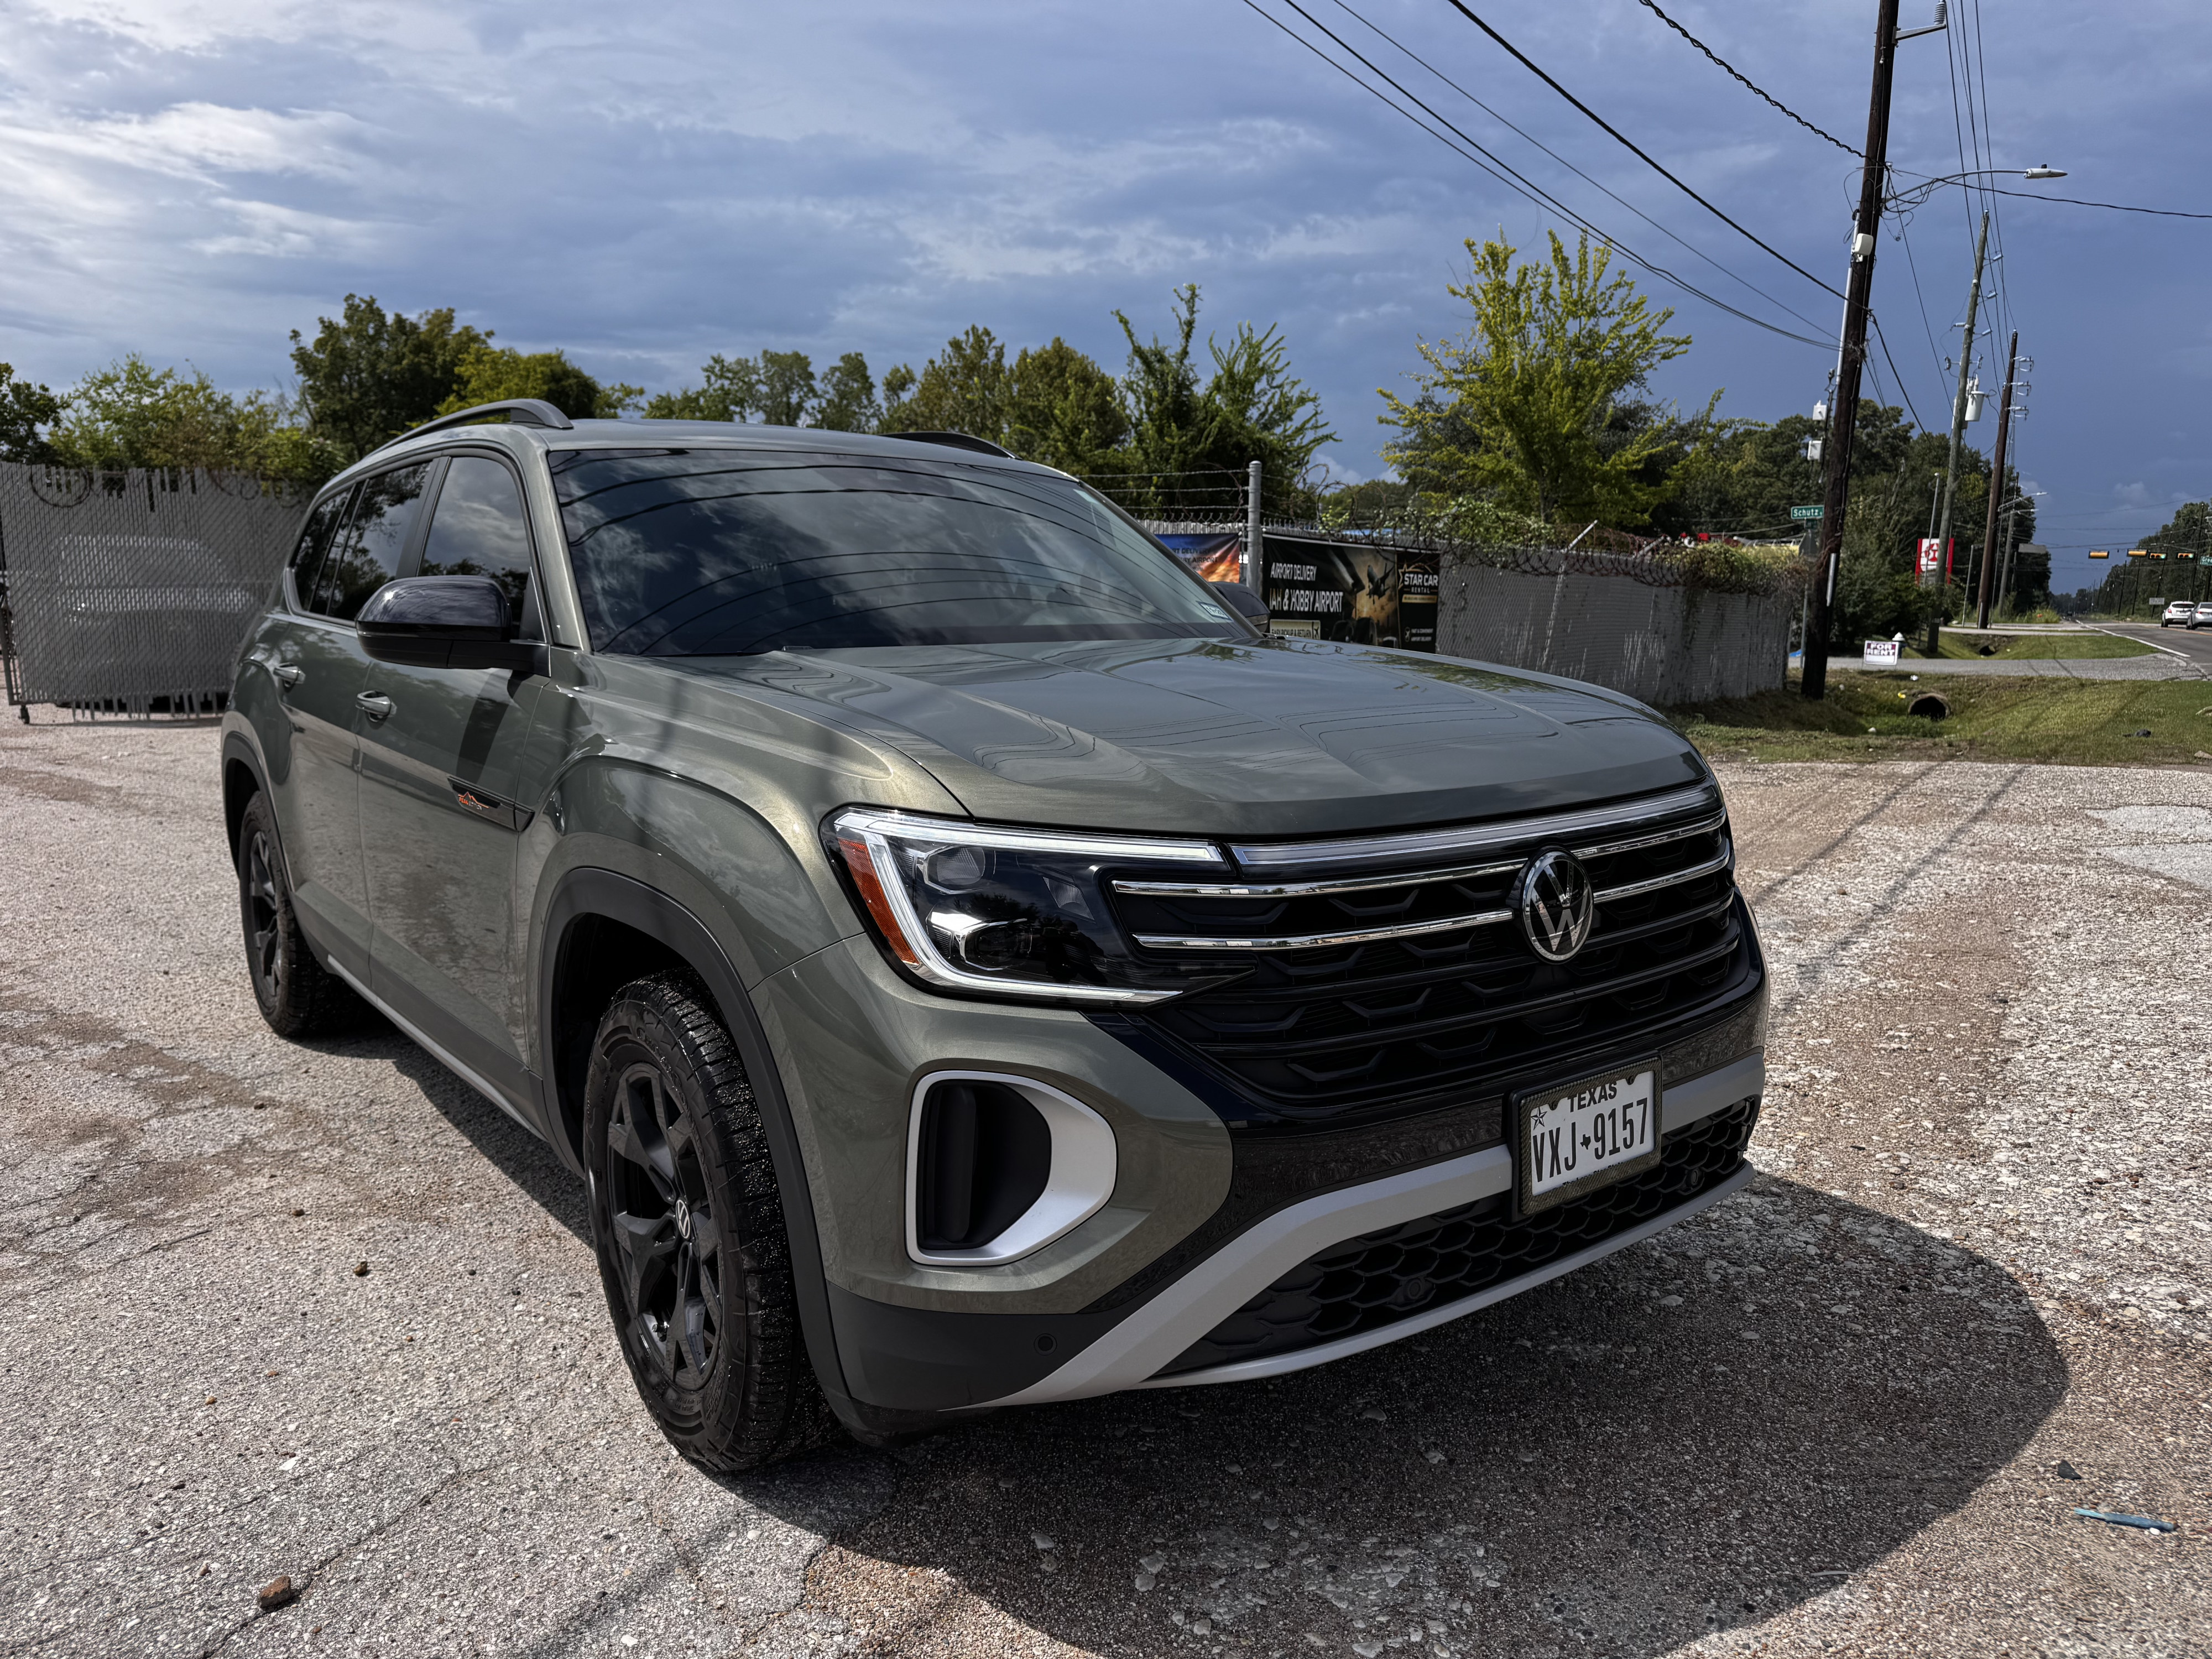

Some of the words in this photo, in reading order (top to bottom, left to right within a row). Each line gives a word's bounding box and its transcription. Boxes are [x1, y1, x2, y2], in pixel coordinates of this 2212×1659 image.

[1793, 508, 1819, 517] Schutz
[1270, 562, 1293, 580] AIRPORT
[1293, 564, 1317, 581] DELIVERY
[1404, 573, 1423, 586] STAR
[1423, 574, 1438, 586] CAR
[1269, 588, 1283, 611] IAH
[1282, 588, 1290, 611] &
[1290, 588, 1314, 612] HOBBY
[1314, 590, 1344, 613] AIRPORT
[1567, 1082, 1618, 1113] TEXAS
[1533, 1121, 1577, 1183] VXJ
[1594, 1097, 1648, 1160] 9157
